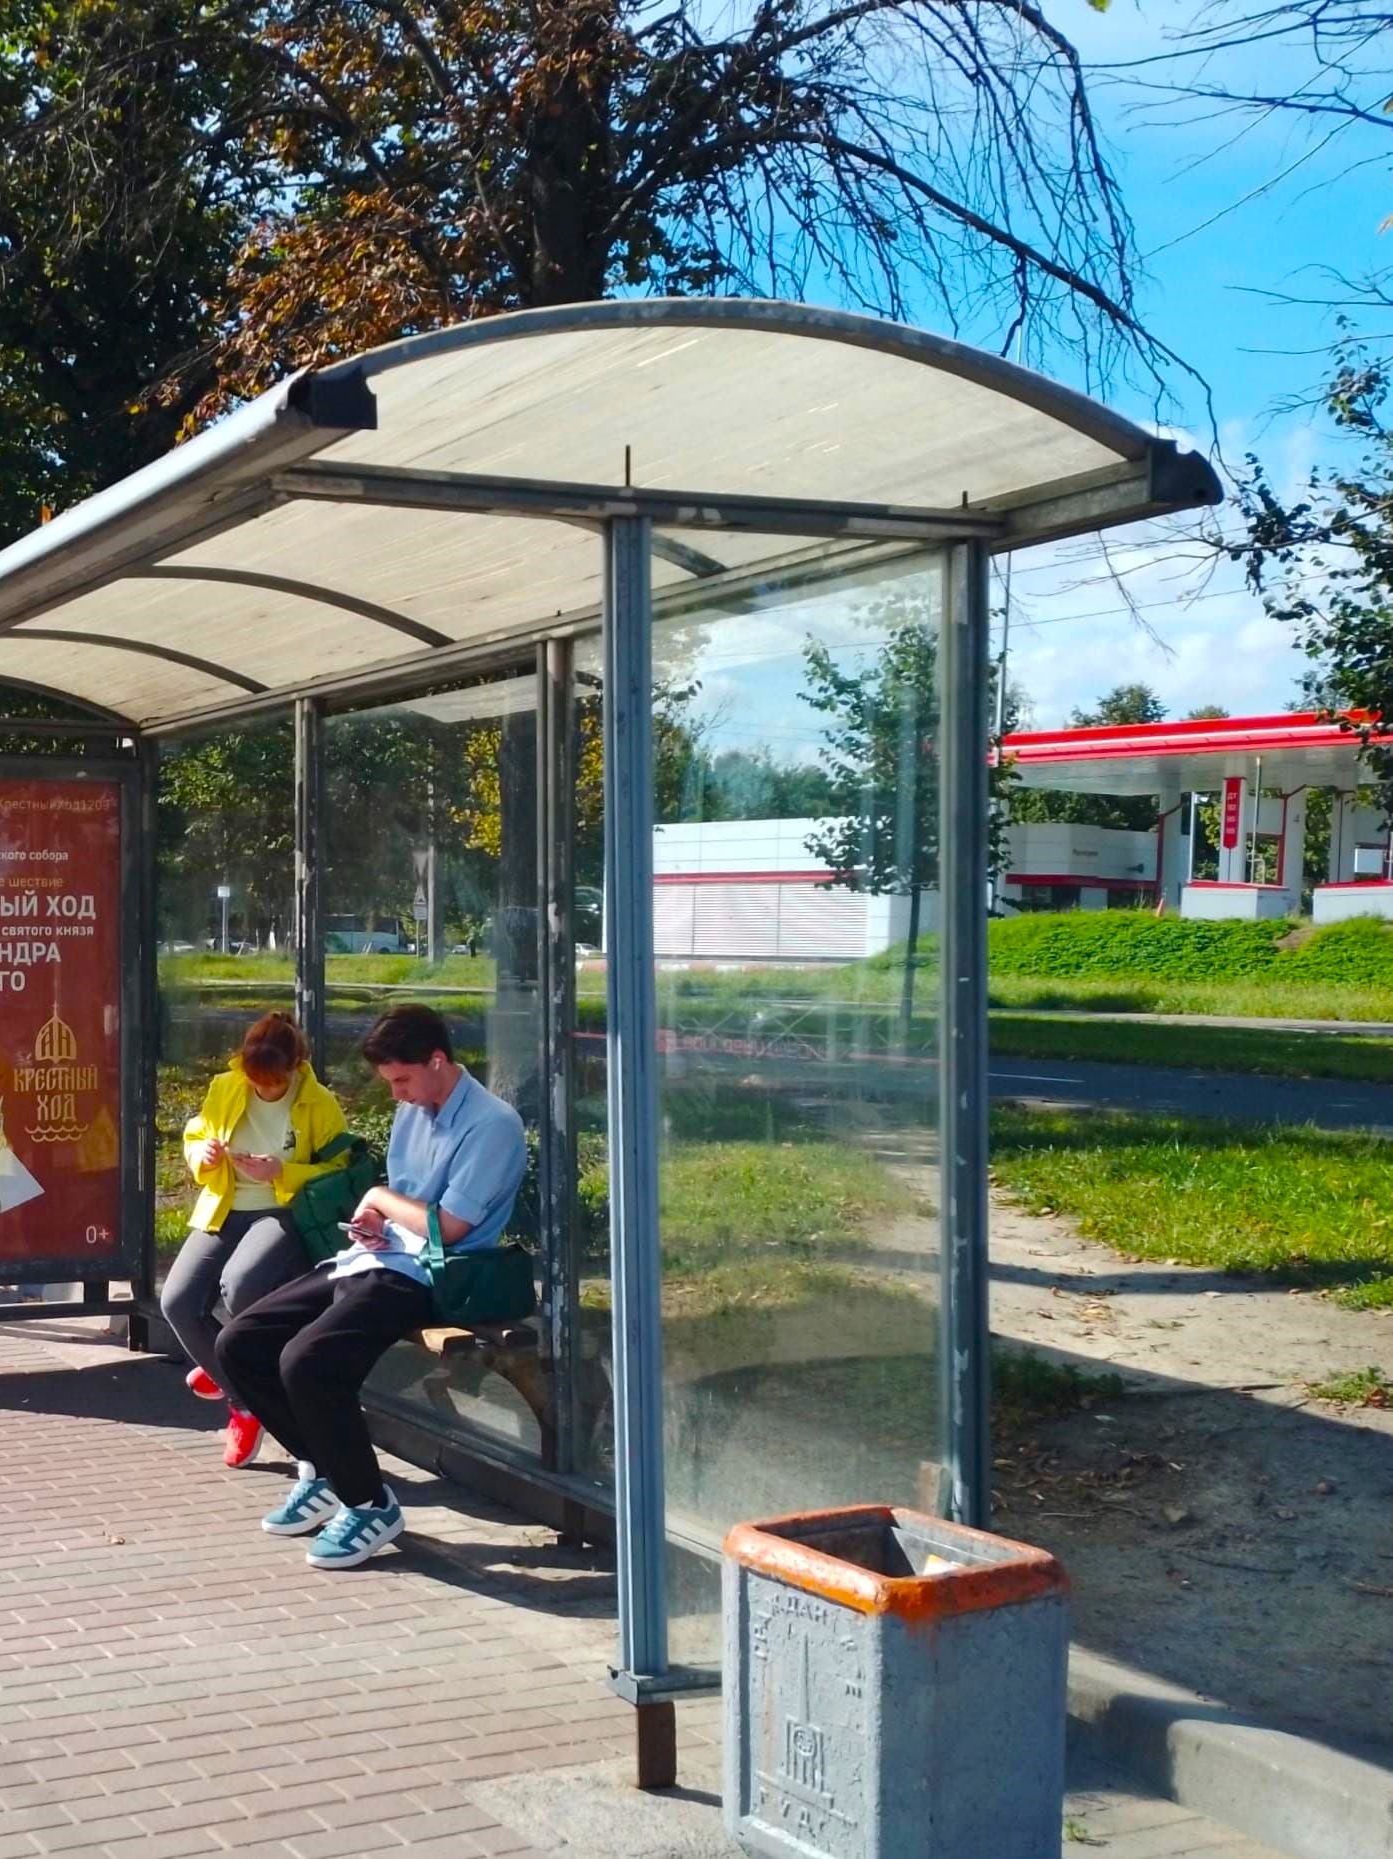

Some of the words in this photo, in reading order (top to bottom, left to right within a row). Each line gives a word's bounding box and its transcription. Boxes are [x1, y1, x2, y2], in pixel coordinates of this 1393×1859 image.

[29, 850, 69, 862] собора
[8, 878, 64, 888] шествие
[46, 895, 97, 920] ХОД
[2, 926, 52, 937] святого
[56, 925, 95, 936] князя
[14, 1064, 98, 1092] КРЕСТНЫЙ
[37, 1094, 77, 1122] ХОД
[86, 1225, 109, 1244] 0+
